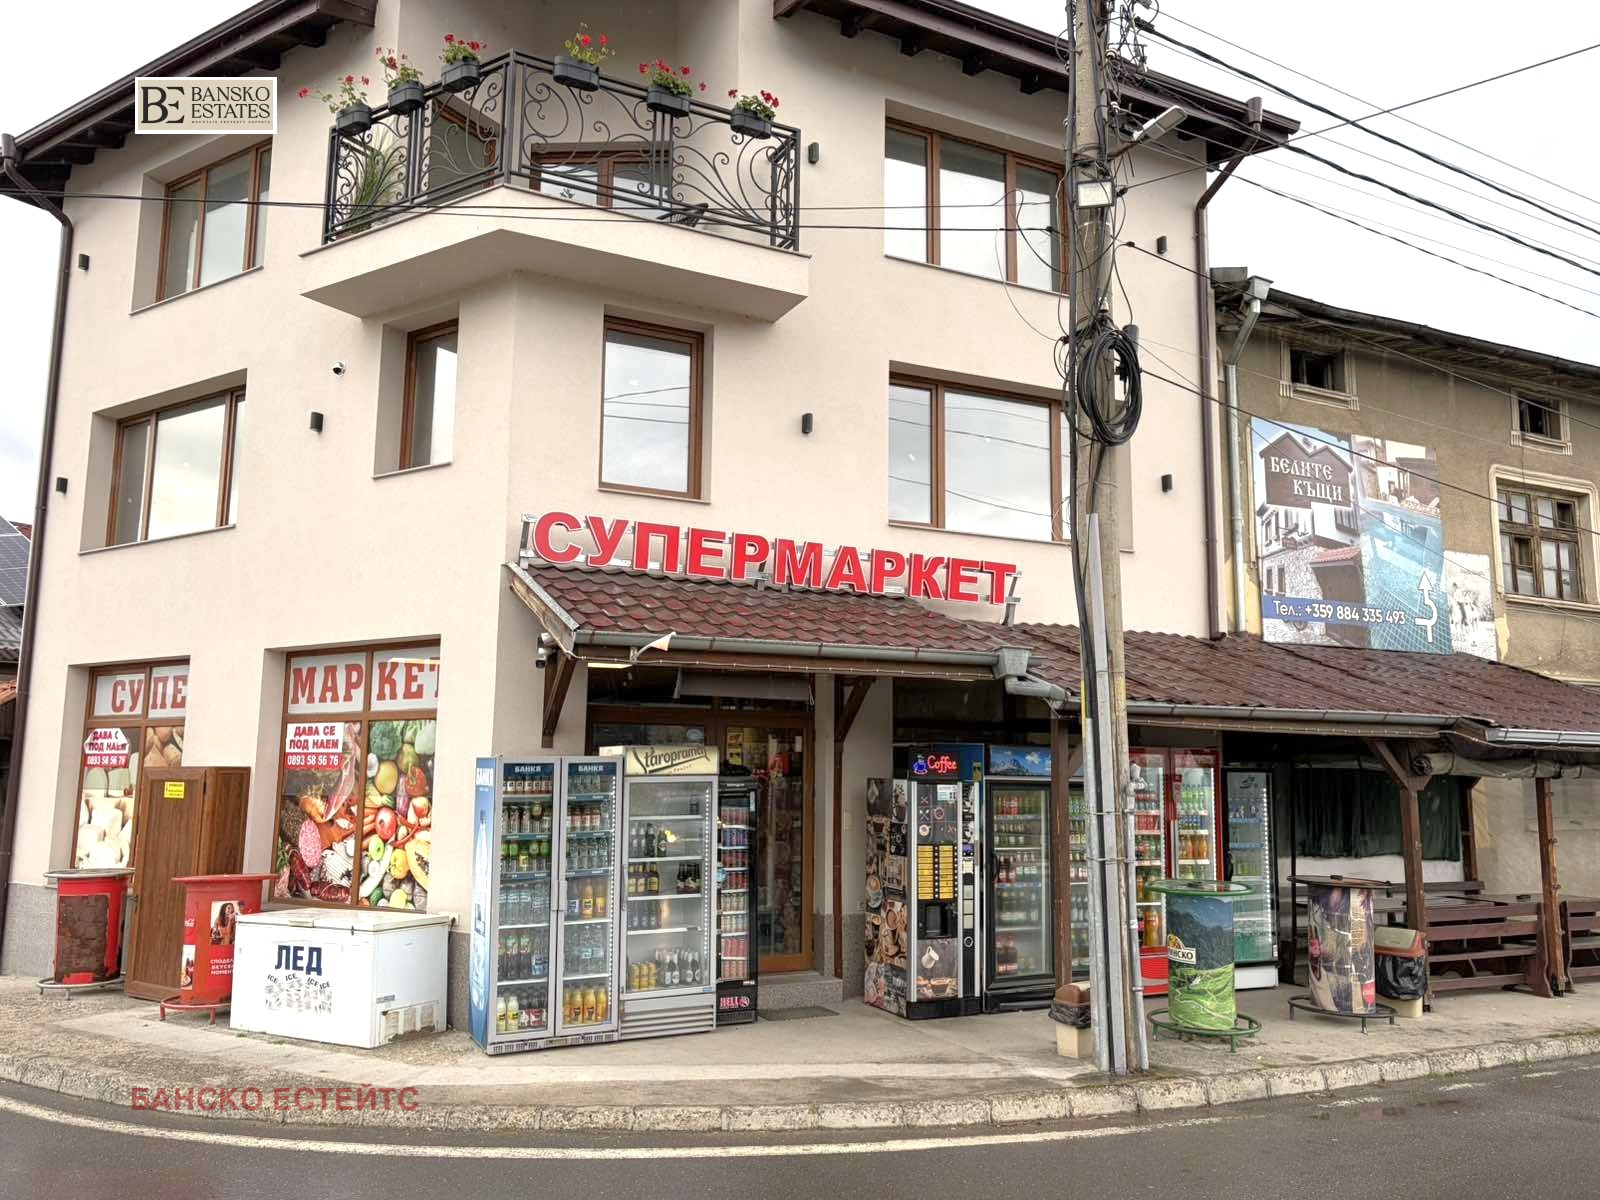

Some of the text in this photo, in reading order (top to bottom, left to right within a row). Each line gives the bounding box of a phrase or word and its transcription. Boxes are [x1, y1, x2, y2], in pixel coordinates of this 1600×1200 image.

[1293, 479, 1343, 503] КЪЩИ
[533, 511, 1017, 605] СУПЕРМАРКЕТ
[1305, 603, 1333, 618] +359
[1336, 605, 1360, 620] 884
[1362, 608, 1383, 622] 335
[1386, 610, 1405, 625] 493
[92, 731, 112, 741] ДАВА
[294, 726, 335, 738] ДАВА СЕ
[88, 743, 104, 753] ПОД
[288, 739, 339, 750] ПОД НАЕМ
[287, 755, 339, 766] 0893 58 56 76
[927, 754, 958, 773] Coffee
[275, 944, 322, 976] ЛЕД
[285, 973, 297, 981] ICE
